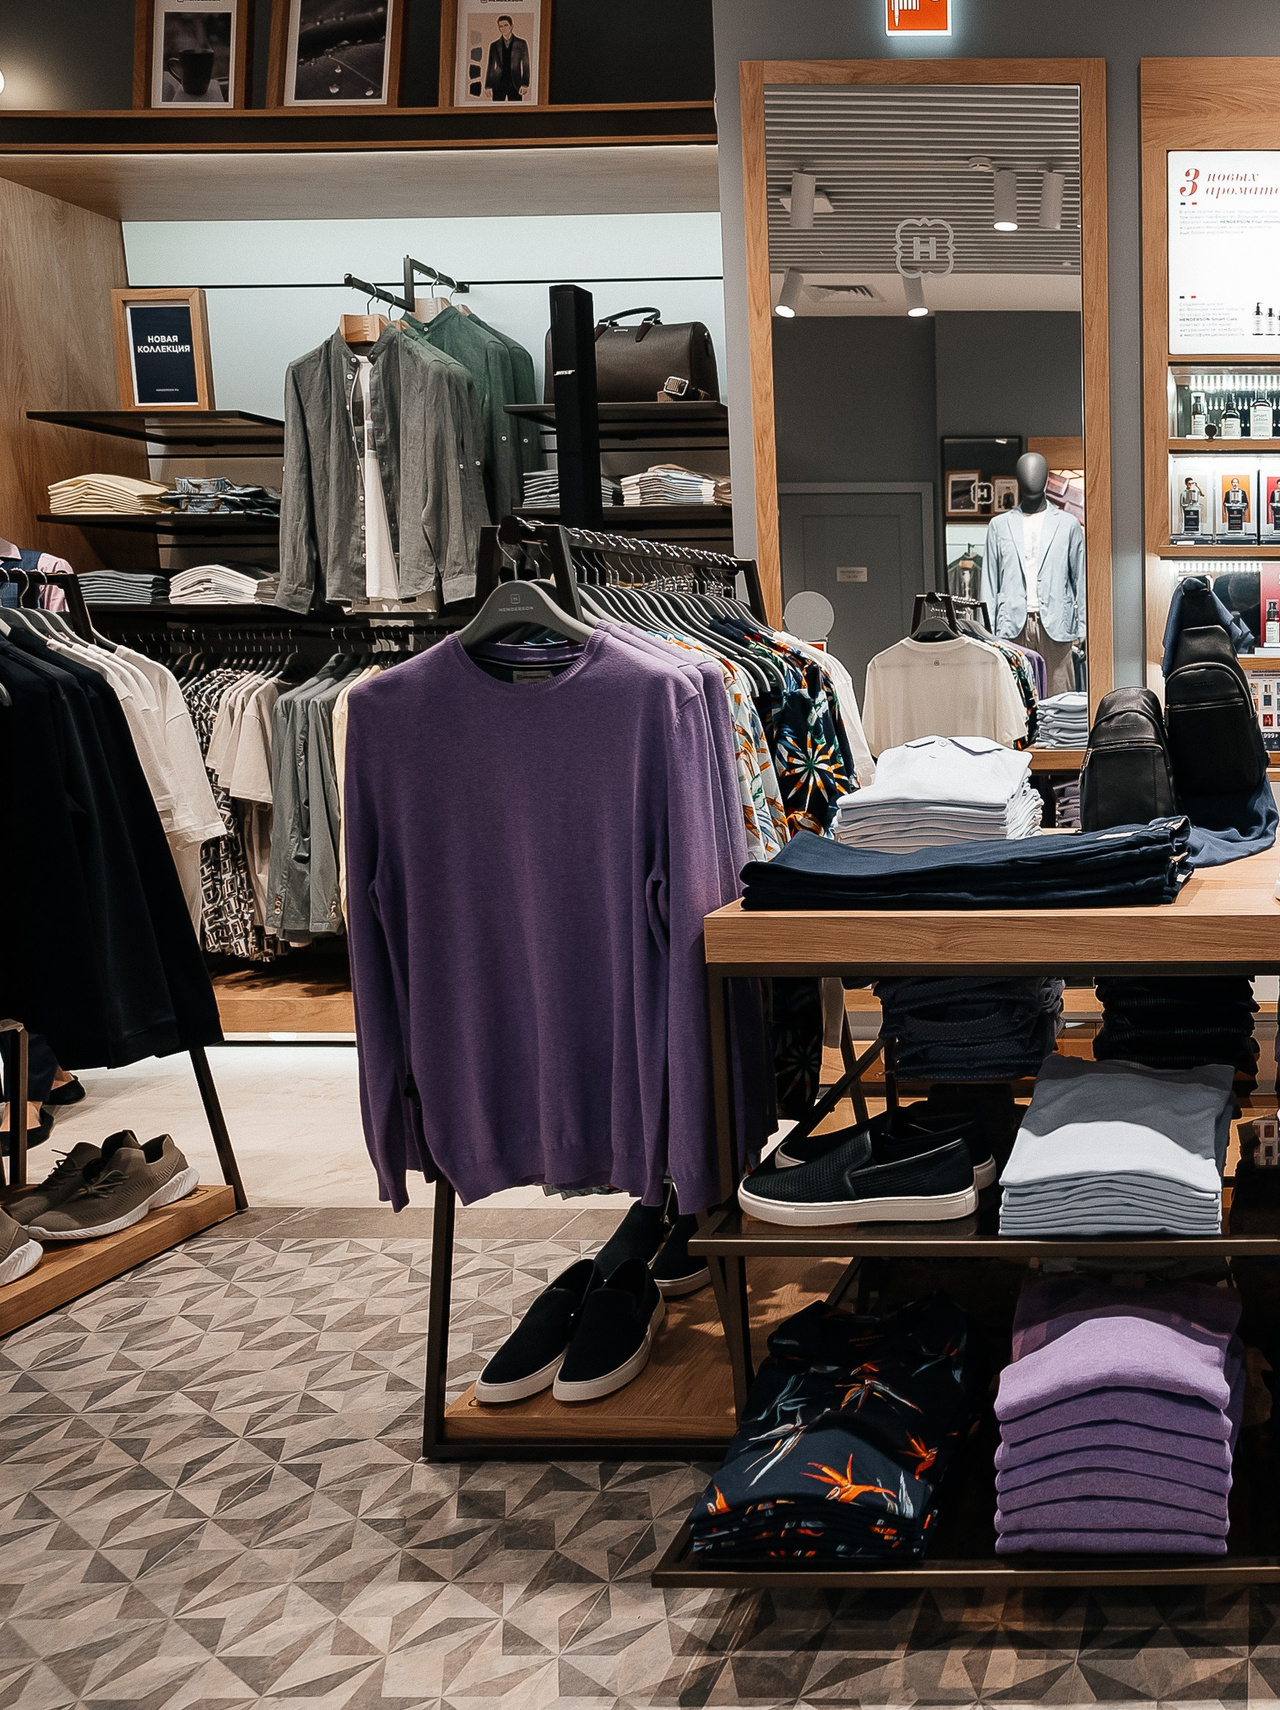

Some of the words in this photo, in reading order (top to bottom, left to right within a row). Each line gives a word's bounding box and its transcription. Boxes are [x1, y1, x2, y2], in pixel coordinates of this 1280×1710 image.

[1180, 168, 1200, 196] 3
[1208, 173, 1259, 182] новых
[913, 237, 936, 260] H
[148, 335, 178, 343] НОВАЯ
[137, 345, 190, 354] КОЛЛЕКЦИЯ
